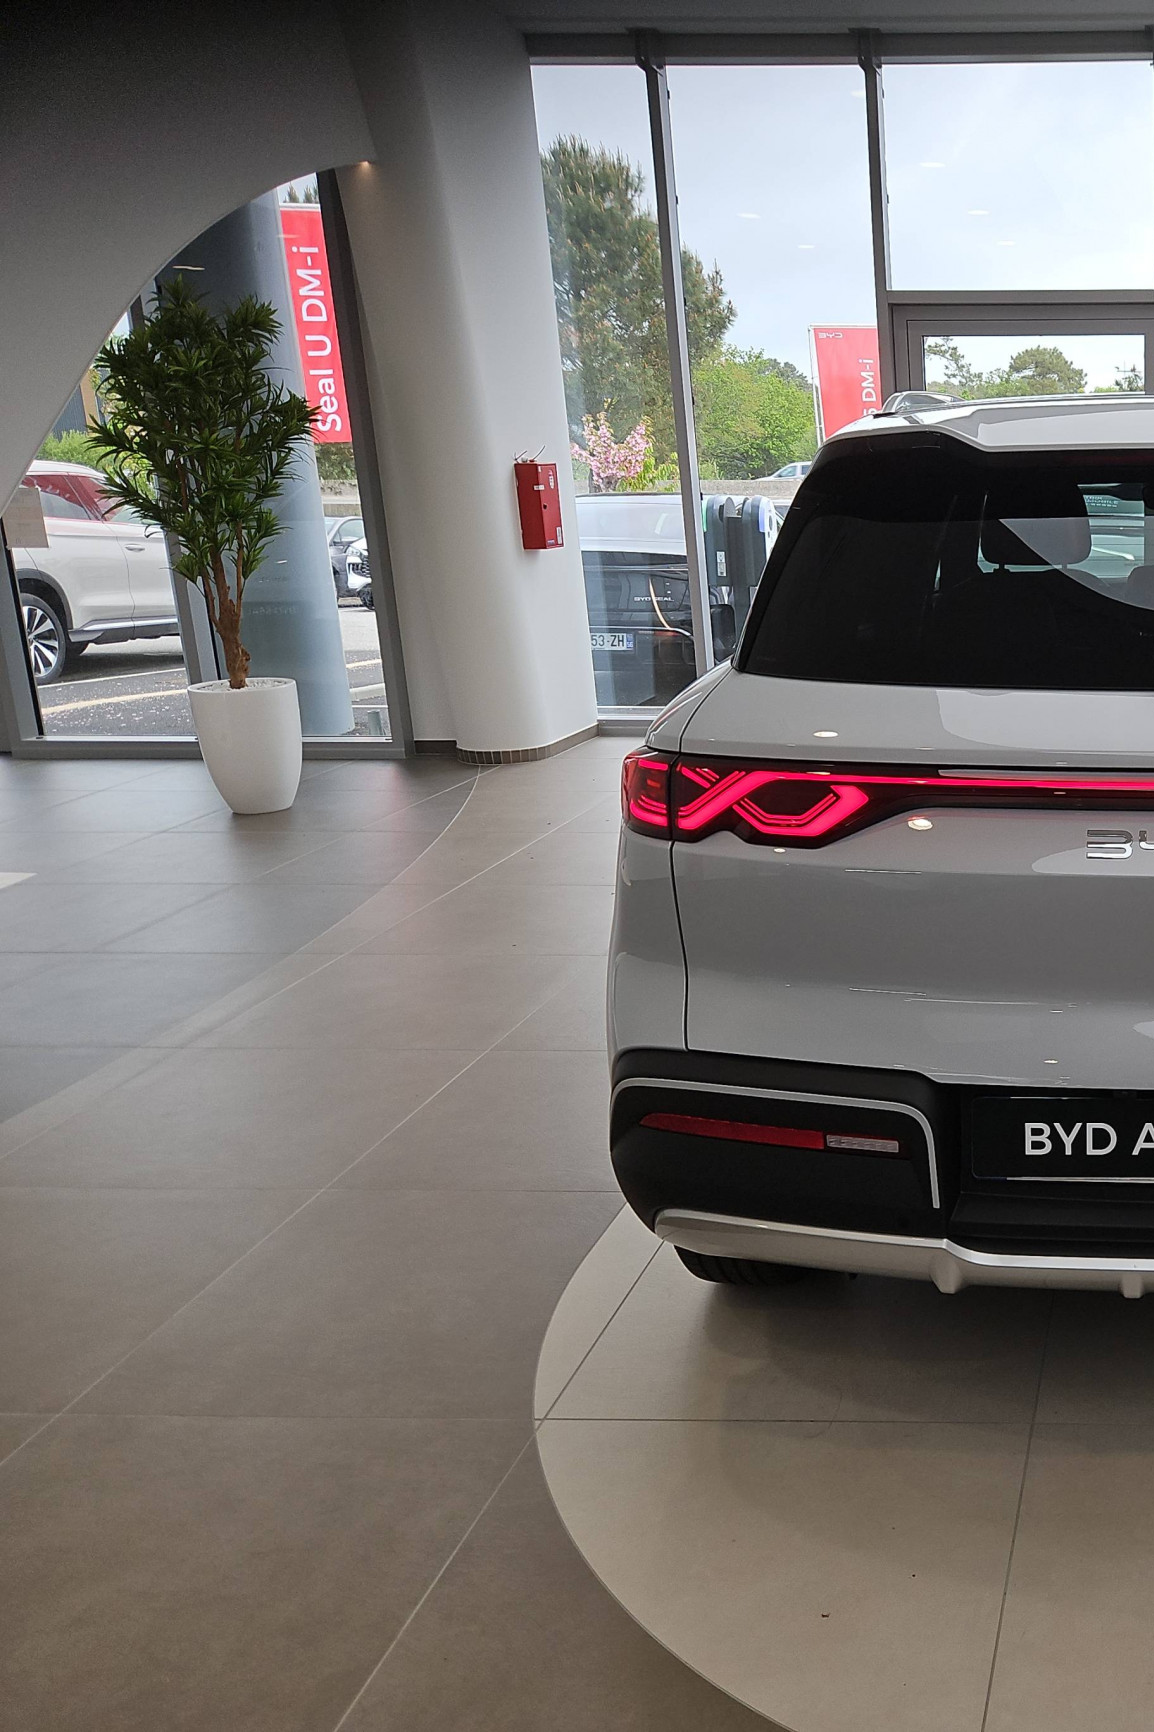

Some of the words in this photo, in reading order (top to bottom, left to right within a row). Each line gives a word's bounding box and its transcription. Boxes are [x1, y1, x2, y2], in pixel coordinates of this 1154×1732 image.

[292, 246, 327, 322] DM-i
[305, 335, 332, 357] U
[309, 368, 342, 432] Seal
[859, 359, 876, 402] DM-i
[1023, 1122, 1118, 1156] BYD
